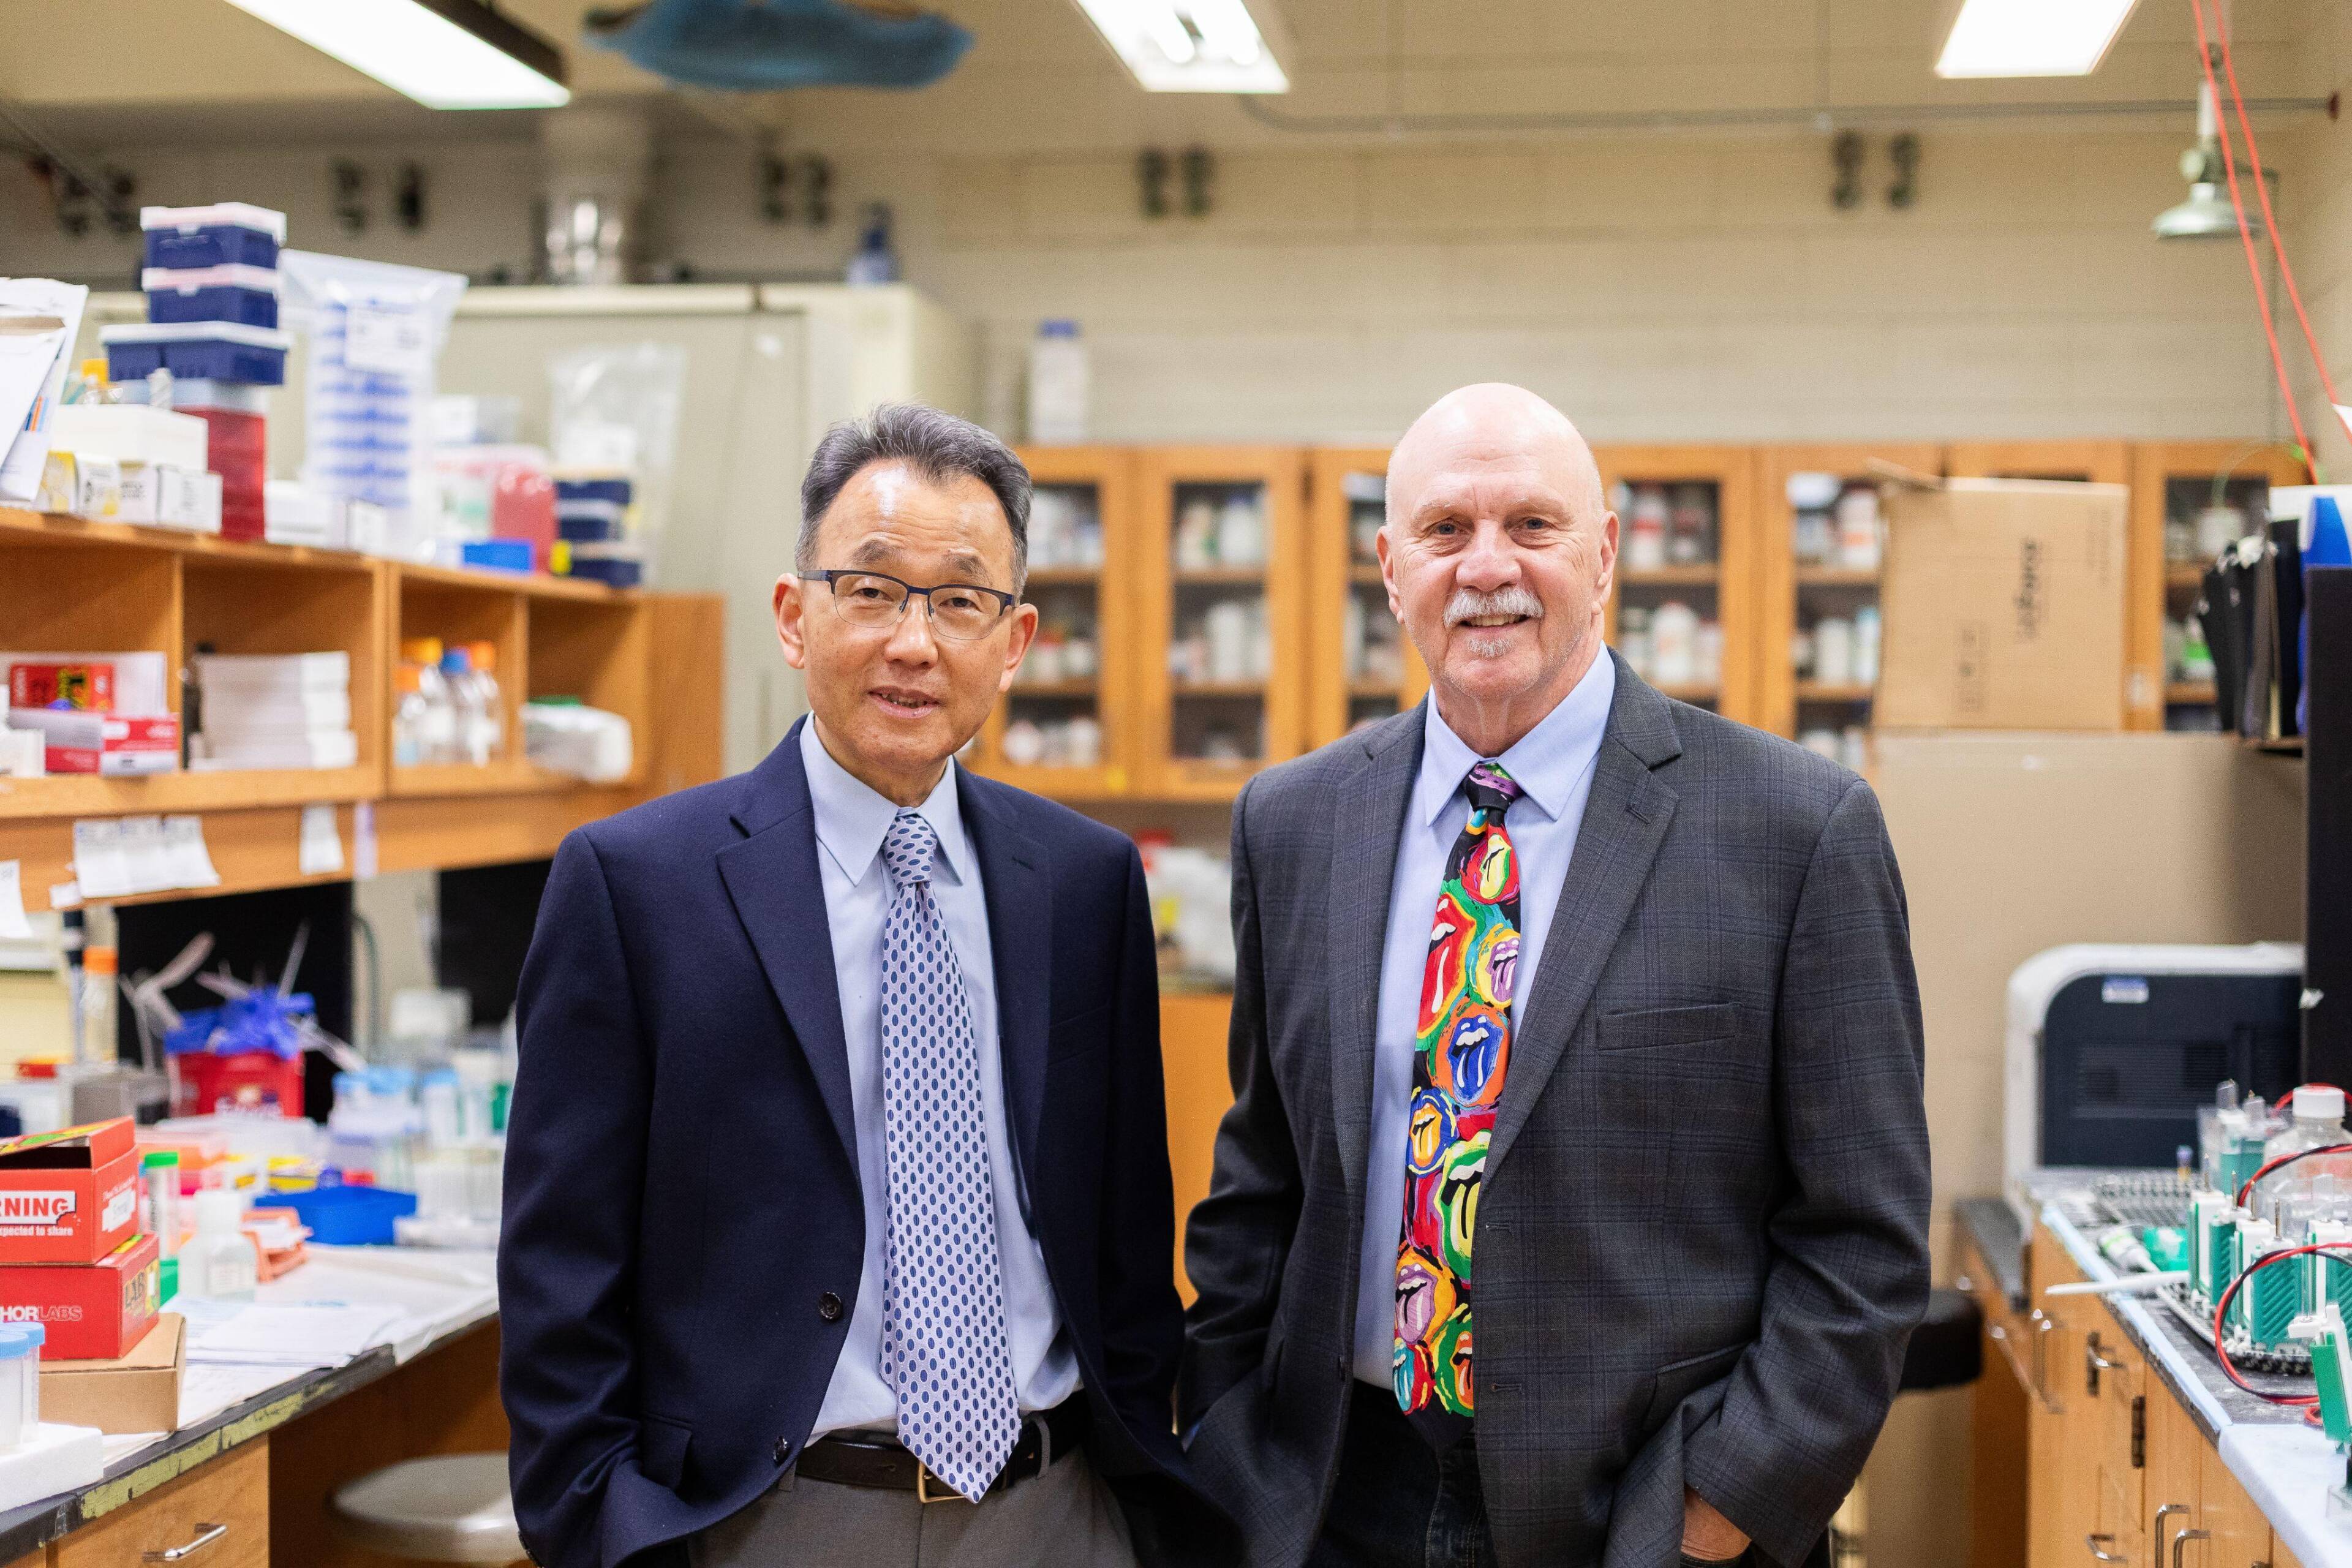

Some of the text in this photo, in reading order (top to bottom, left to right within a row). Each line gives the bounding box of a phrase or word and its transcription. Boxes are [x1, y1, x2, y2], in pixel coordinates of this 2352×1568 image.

[0, 1198, 68, 1216] NING
[36, 1226, 45, 1236] to
[47, 1226, 73, 1236] share
